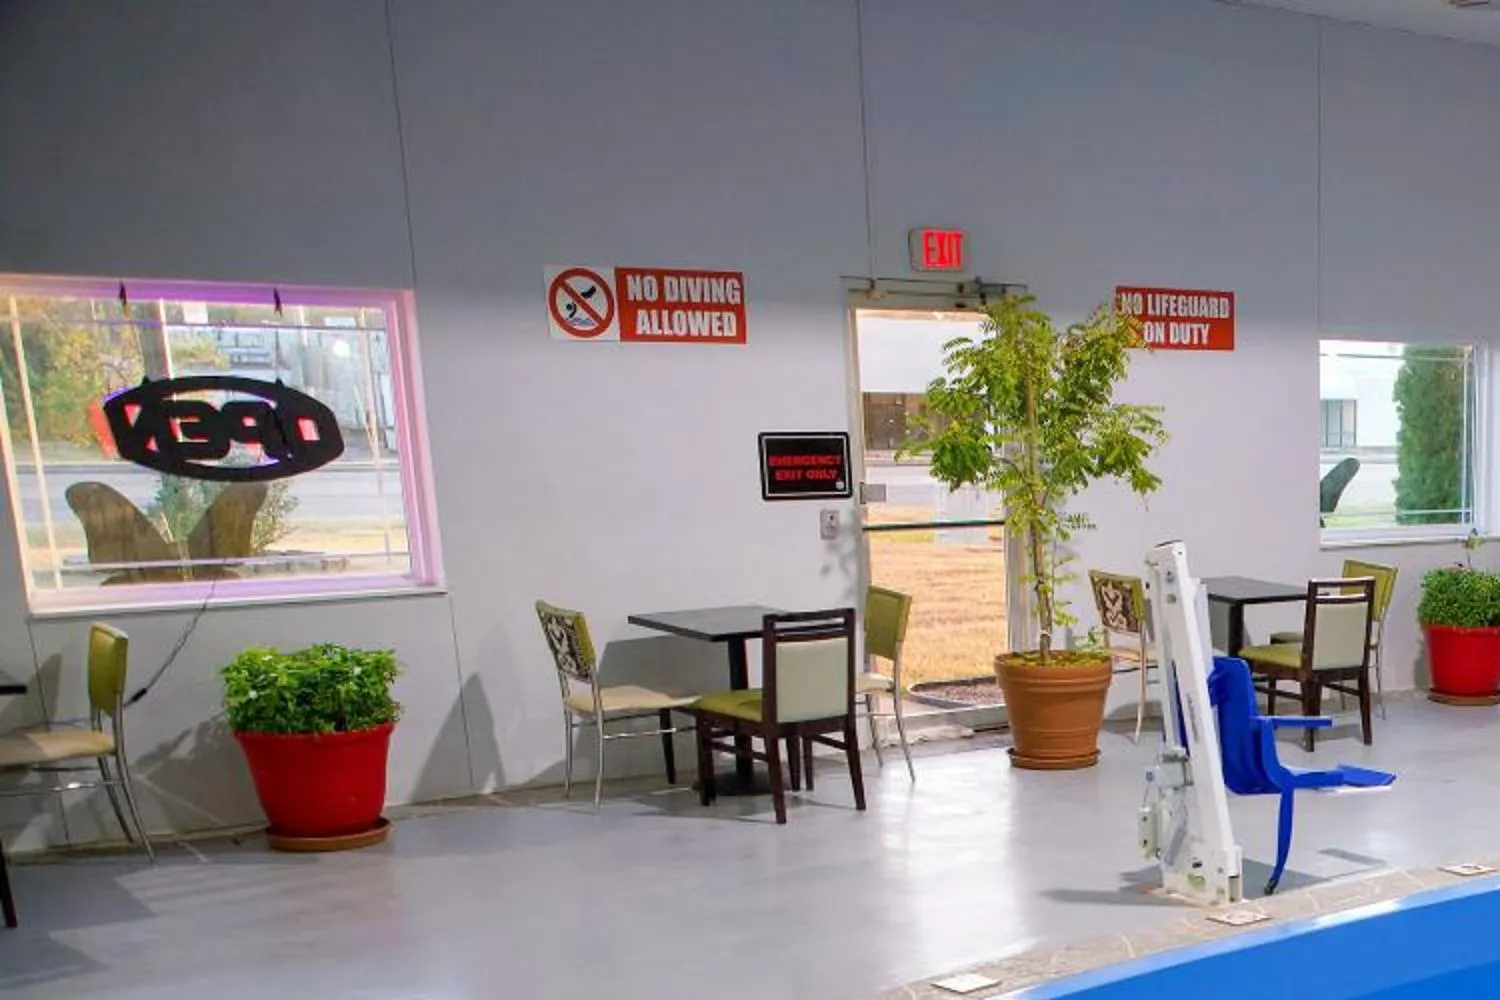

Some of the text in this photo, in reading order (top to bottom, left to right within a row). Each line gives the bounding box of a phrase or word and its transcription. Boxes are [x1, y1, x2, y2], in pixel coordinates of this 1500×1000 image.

[922, 229, 963, 269] EXIT
[625, 273, 742, 305] NO DIVING
[1121, 292, 1230, 319] NO LIFEGUARD
[636, 309, 738, 337] ALLOWED
[1144, 321, 1211, 345] ON DUTY
[805, 468, 837, 480] ONLY
